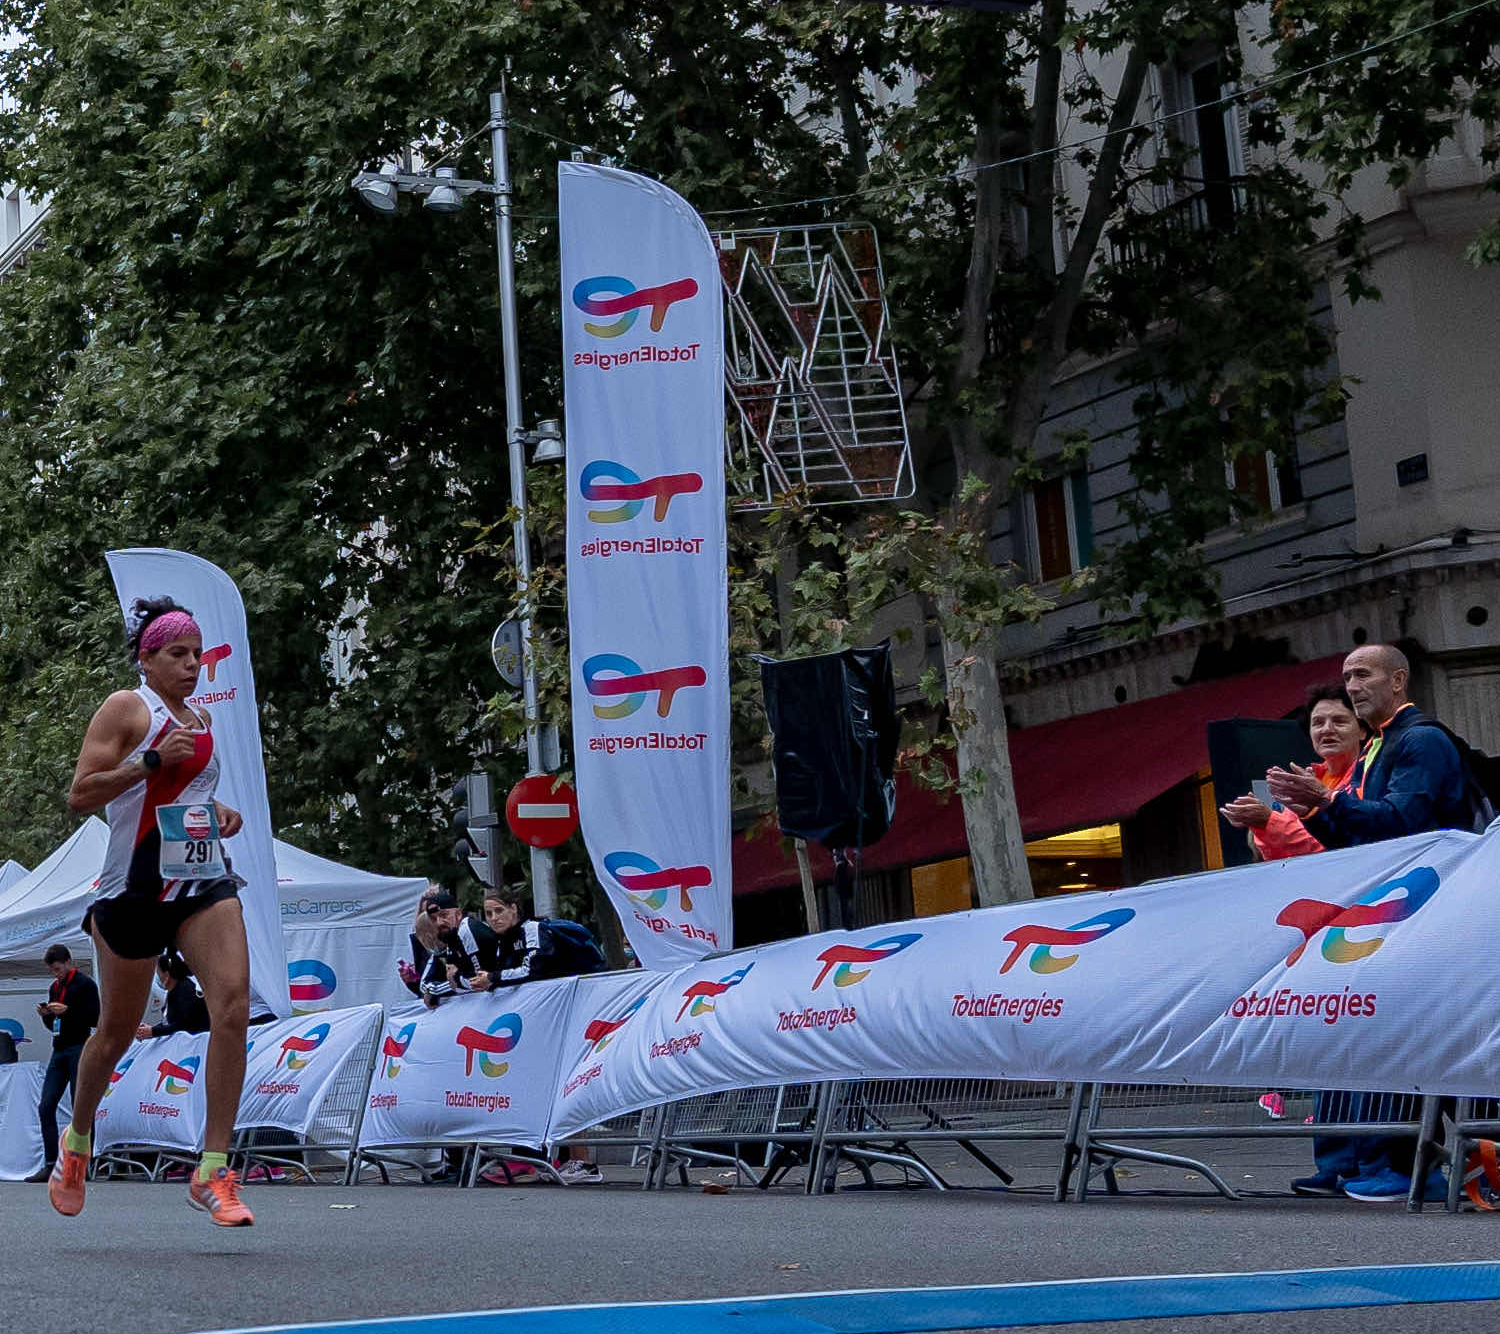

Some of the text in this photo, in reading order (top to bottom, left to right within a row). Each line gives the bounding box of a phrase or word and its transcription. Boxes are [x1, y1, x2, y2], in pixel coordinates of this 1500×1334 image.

[185, 841, 212, 863] 291
[776, 1003, 856, 1033] TotalEnergies
[951, 992, 1065, 1023] TotalEnergies
[445, 1091, 510, 1112] TotalEnergies
